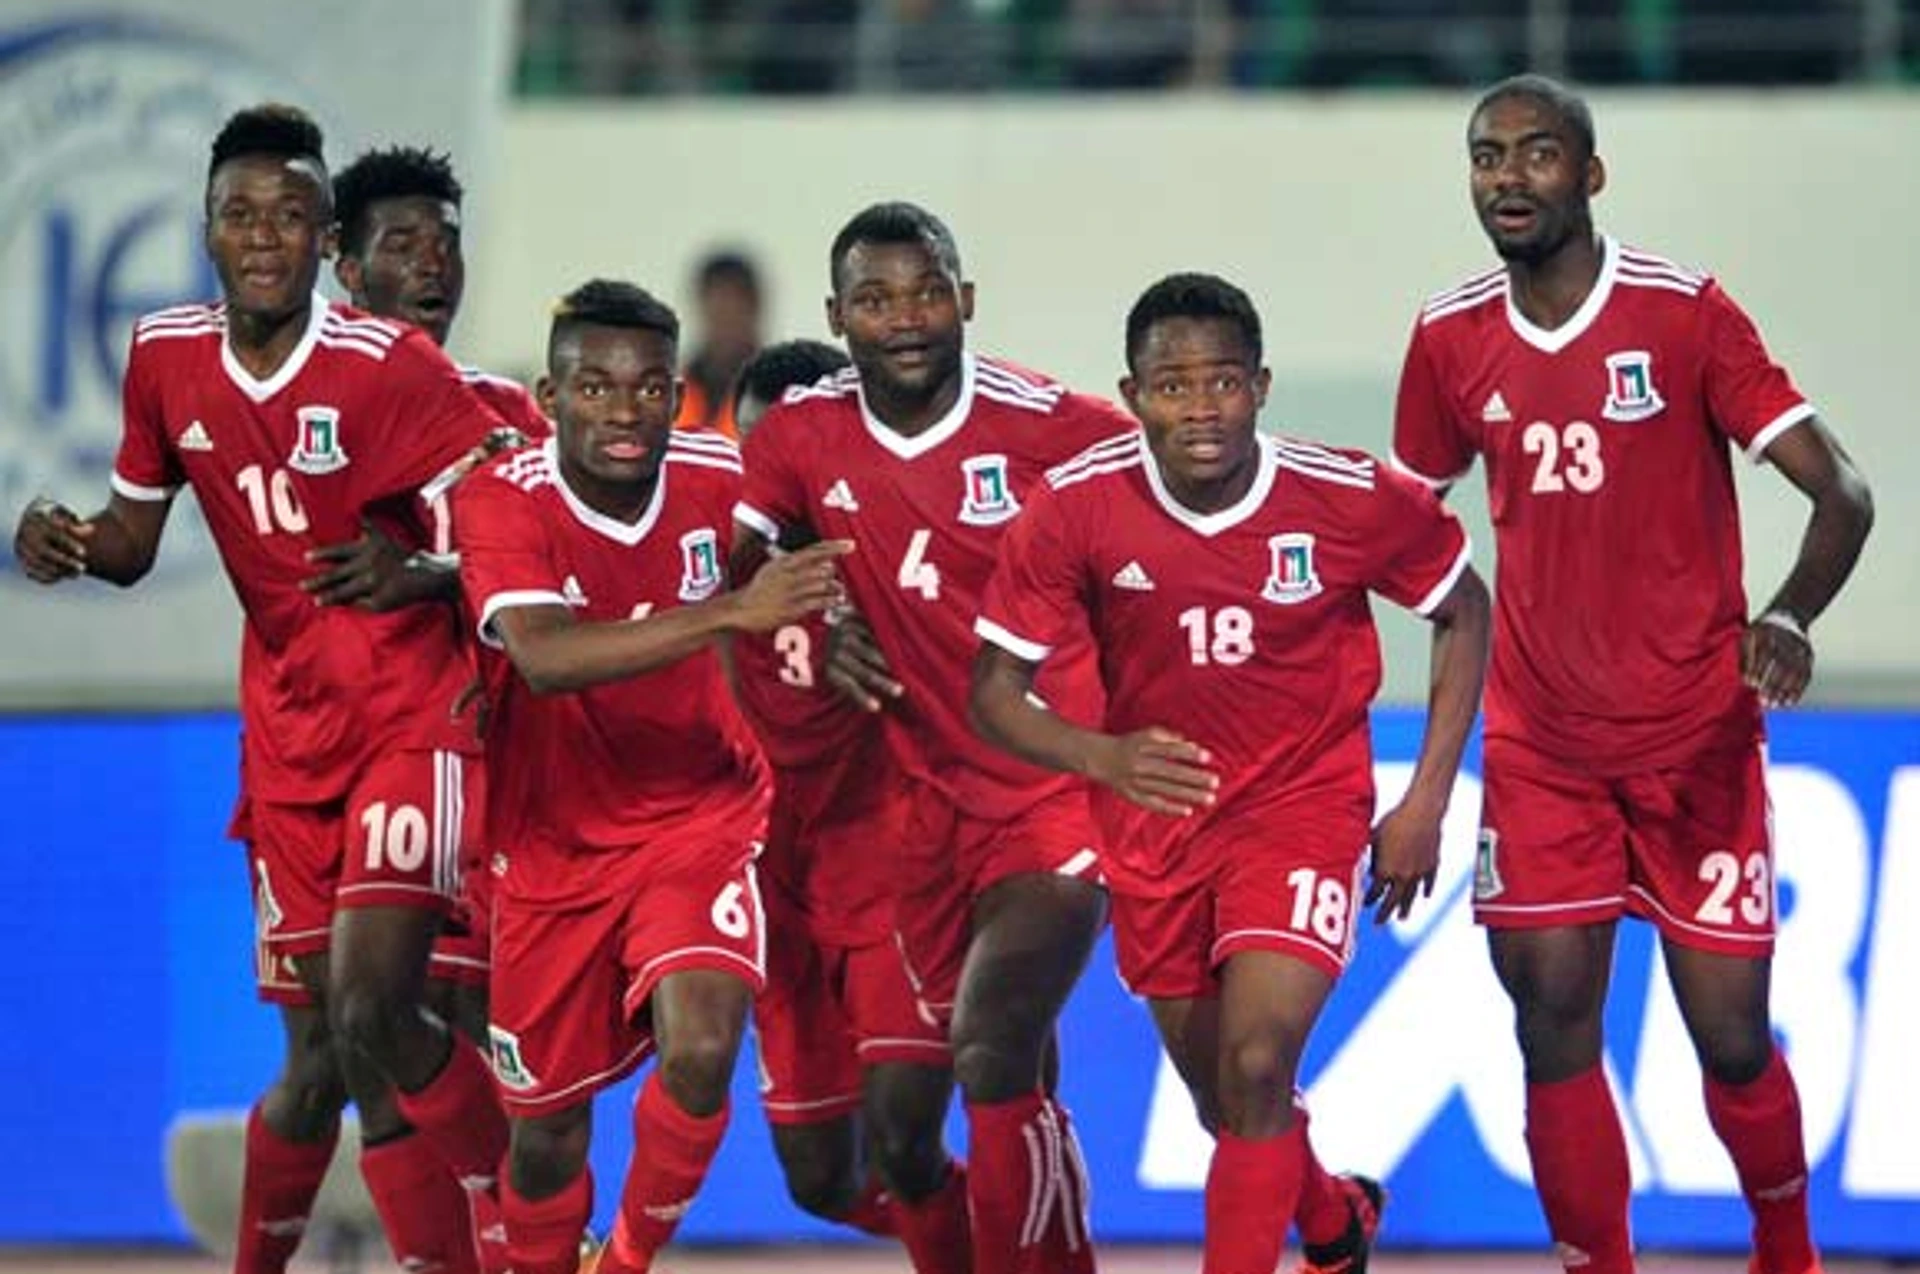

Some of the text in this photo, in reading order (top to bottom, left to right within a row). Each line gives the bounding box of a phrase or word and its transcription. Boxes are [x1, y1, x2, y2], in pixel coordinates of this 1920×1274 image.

[1522, 420, 1605, 493] 23
[237, 465, 309, 535] 10
[897, 529, 940, 600] 4
[774, 625, 814, 687] 3
[1178, 605, 1255, 666] 18
[361, 801, 429, 872] 10
[711, 881, 749, 939] 6
[1287, 867, 1349, 945] 18
[1695, 850, 1769, 925] 23
